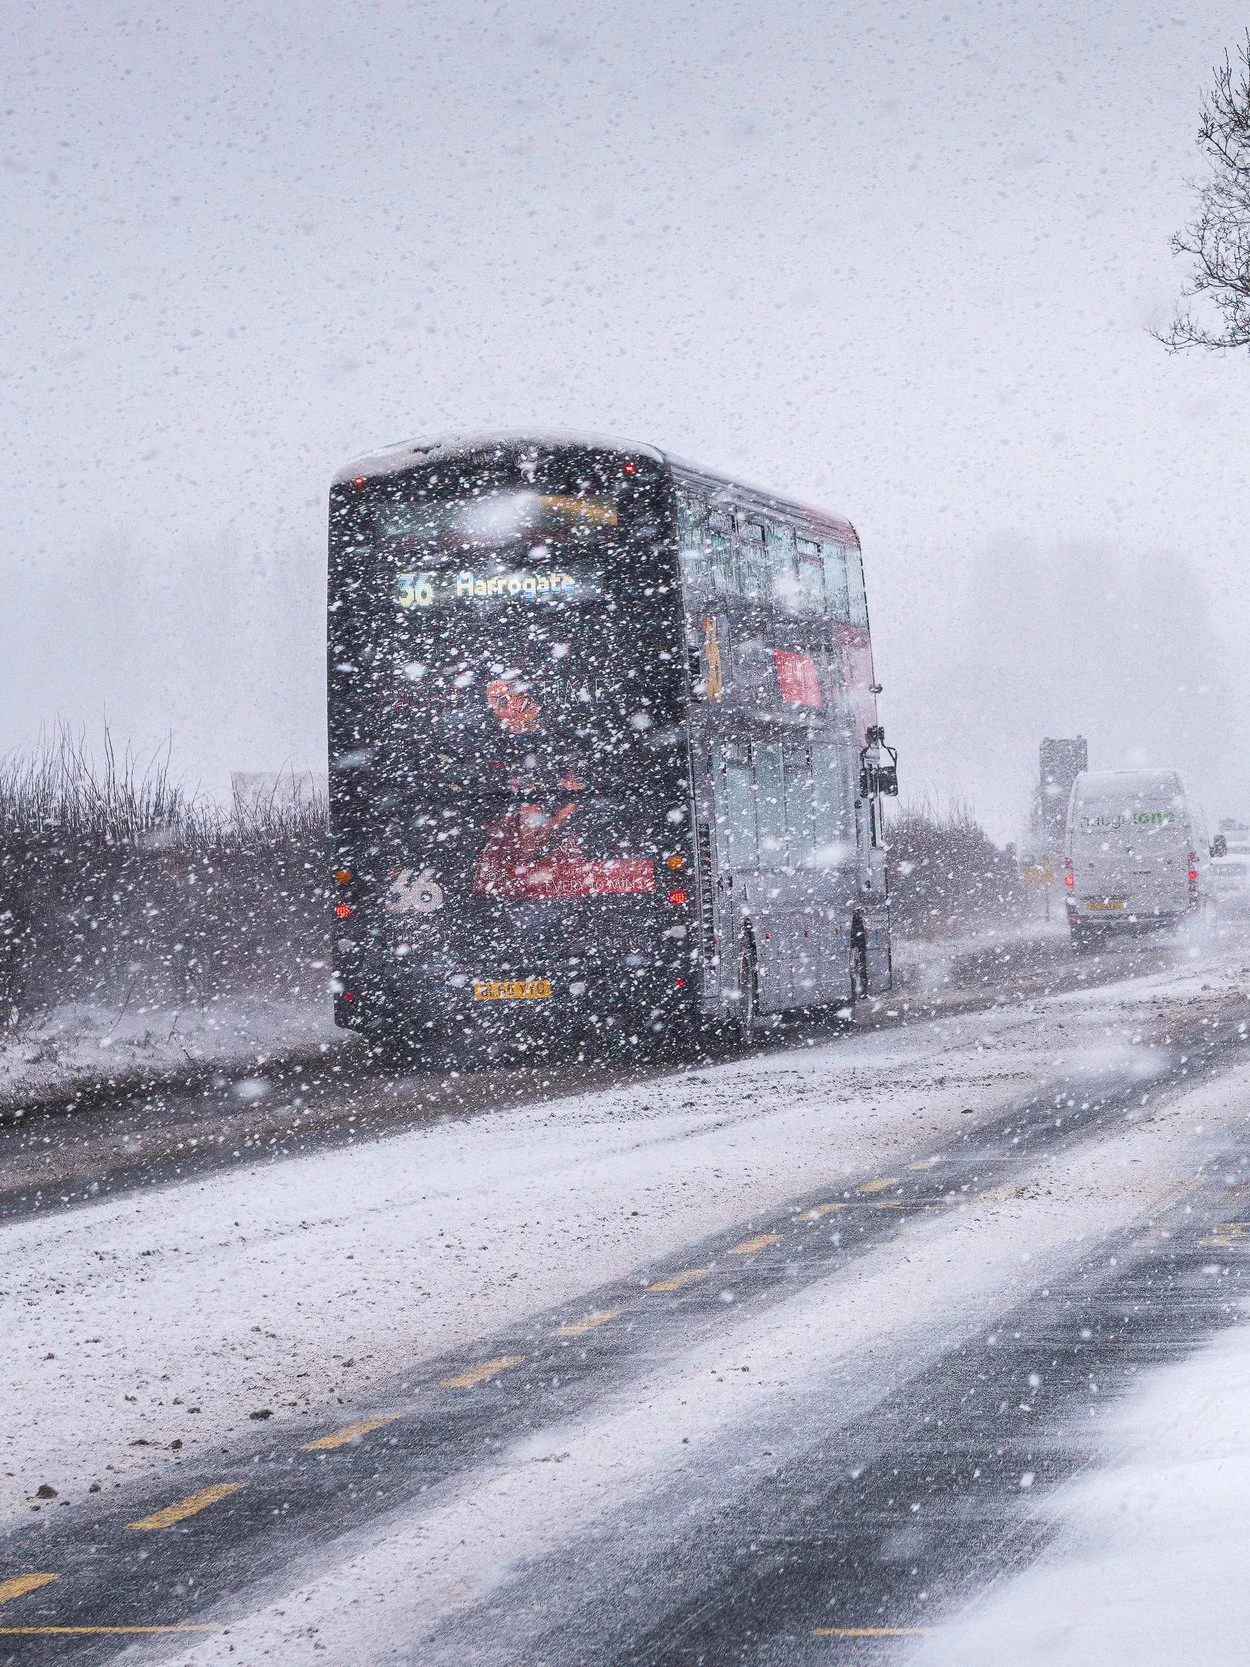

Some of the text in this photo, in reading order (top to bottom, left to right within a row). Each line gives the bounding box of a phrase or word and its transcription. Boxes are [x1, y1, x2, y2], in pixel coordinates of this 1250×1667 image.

[397, 573, 575, 607] 36 Harrogate
[385, 868, 443, 913] 36
